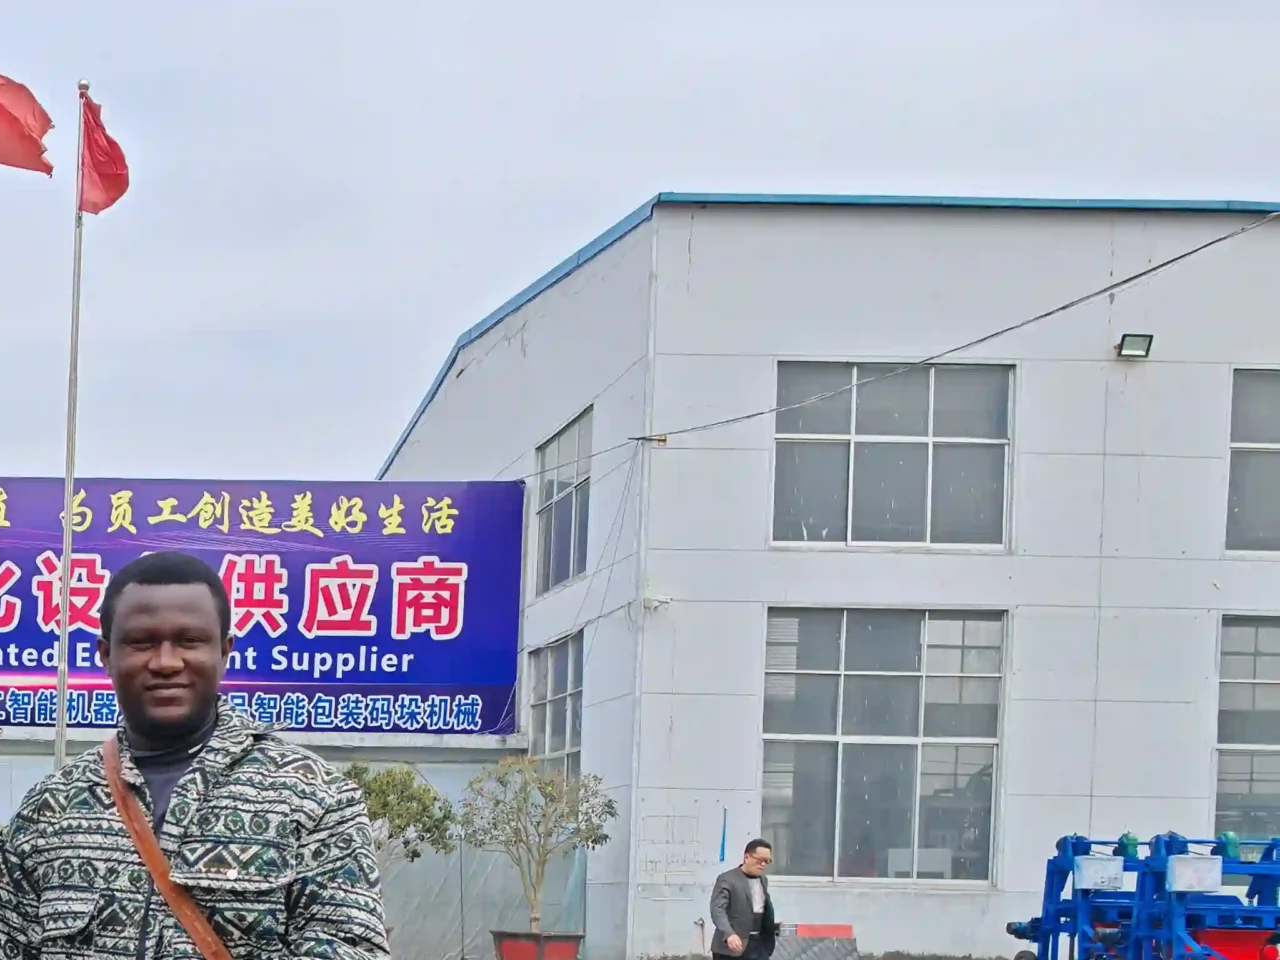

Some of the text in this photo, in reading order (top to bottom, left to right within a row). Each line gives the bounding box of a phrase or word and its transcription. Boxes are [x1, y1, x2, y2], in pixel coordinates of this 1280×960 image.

[59, 488, 460, 538] 为员工创造美好生活
[270, 645, 415, 678] Supplier
